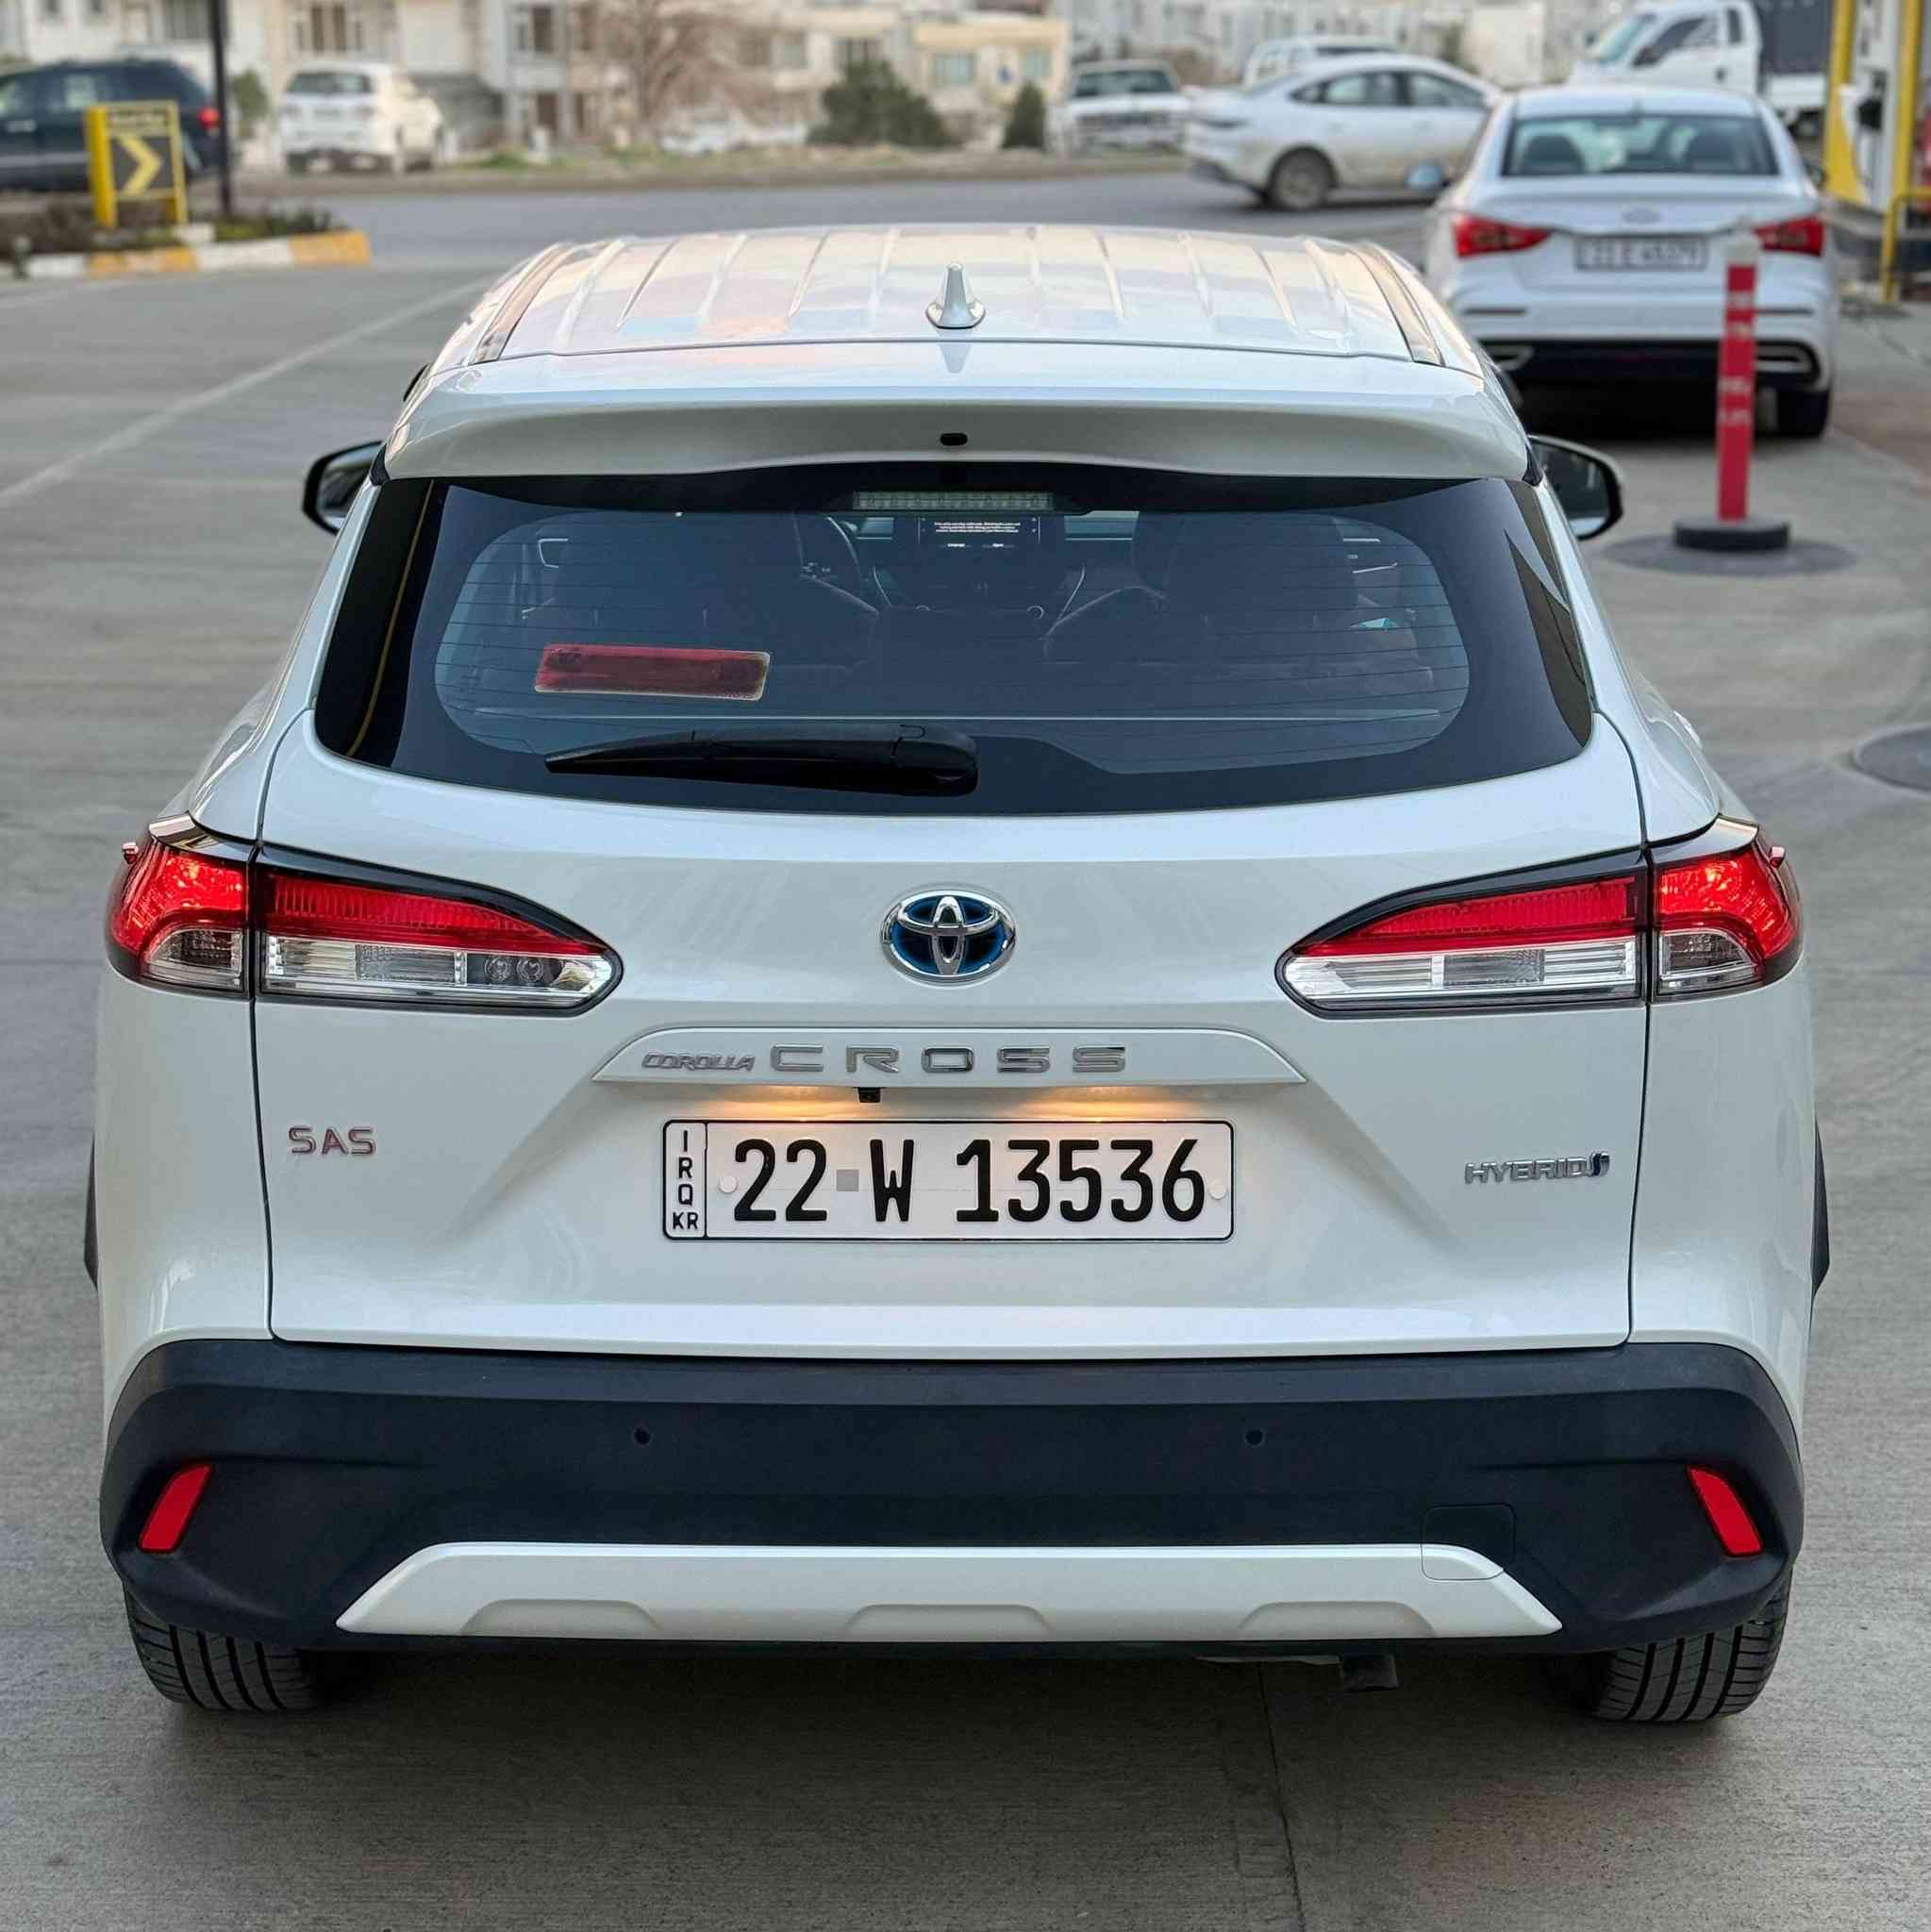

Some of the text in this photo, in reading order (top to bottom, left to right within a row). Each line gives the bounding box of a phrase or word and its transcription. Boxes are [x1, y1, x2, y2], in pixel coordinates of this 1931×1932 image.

[641, 1043, 1126, 1074] COROLLA CROSS
[288, 1125, 376, 1155] SAS
[733, 1139, 1206, 1222] 22 W 13536
[1464, 1157, 1588, 1184] HYBRID
[672, 1211, 699, 1230] KR
